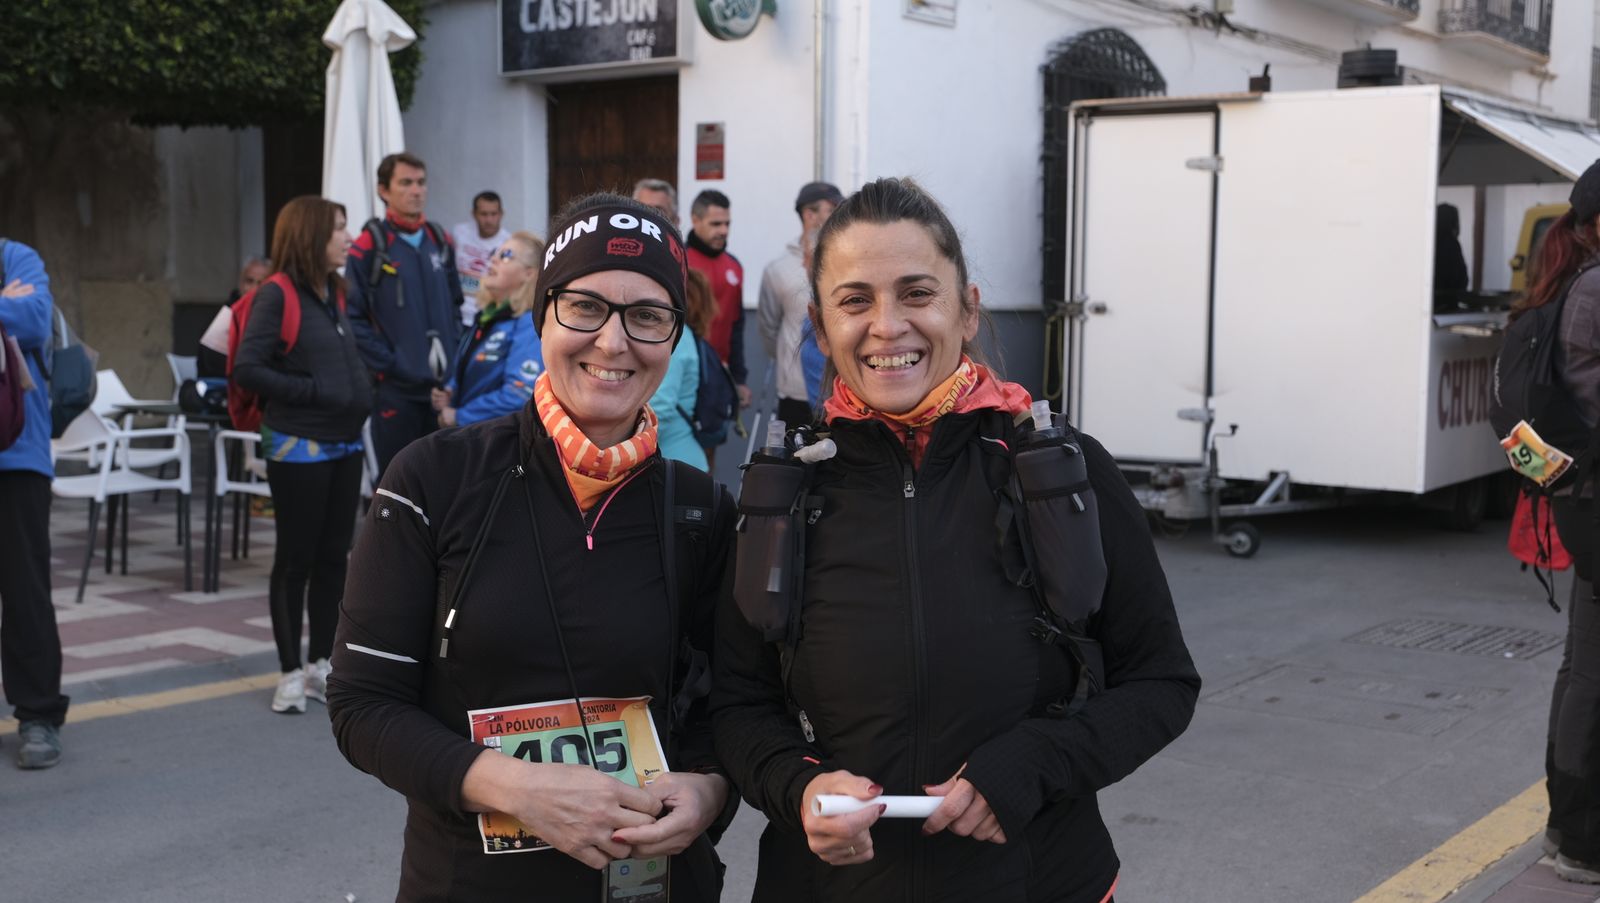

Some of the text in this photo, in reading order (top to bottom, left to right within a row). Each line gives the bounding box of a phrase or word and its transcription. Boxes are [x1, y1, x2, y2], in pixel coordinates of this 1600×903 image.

[543, 215, 598, 270] RUN
[609, 213, 662, 243] OR
[1438, 357, 1491, 430] CHUR
[489, 715, 560, 735] LA PÓLVORA
[582, 703, 617, 715] CANTORIA
